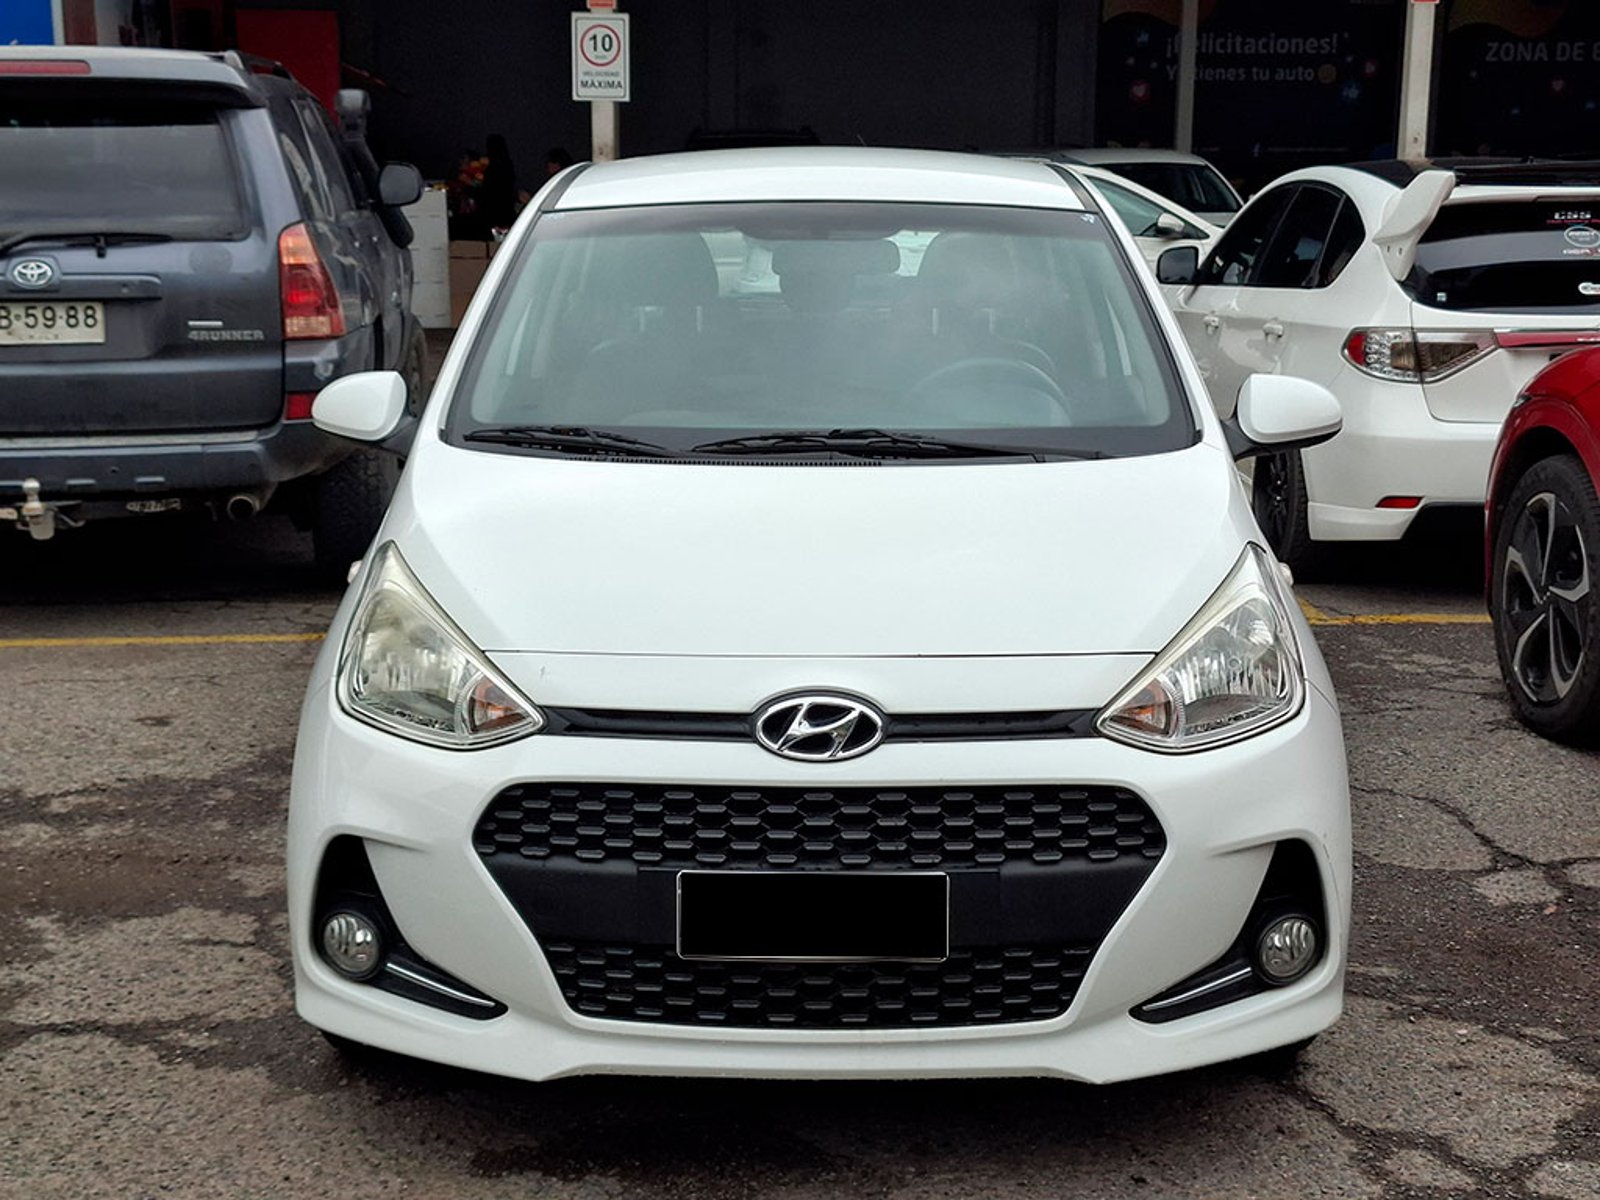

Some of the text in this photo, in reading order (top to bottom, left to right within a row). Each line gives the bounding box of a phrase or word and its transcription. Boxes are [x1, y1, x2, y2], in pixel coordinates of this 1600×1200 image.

[588, 33, 613, 53] 10
[1165, 32, 1339, 58] ¡Flicitaciones!
[1484, 40, 1549, 62] ZONA
[1554, 41, 1586, 62] DE
[1252, 65, 1270, 81] tu
[1274, 65, 1315, 81] auto
[187, 329, 265, 341] 4RUNNER
